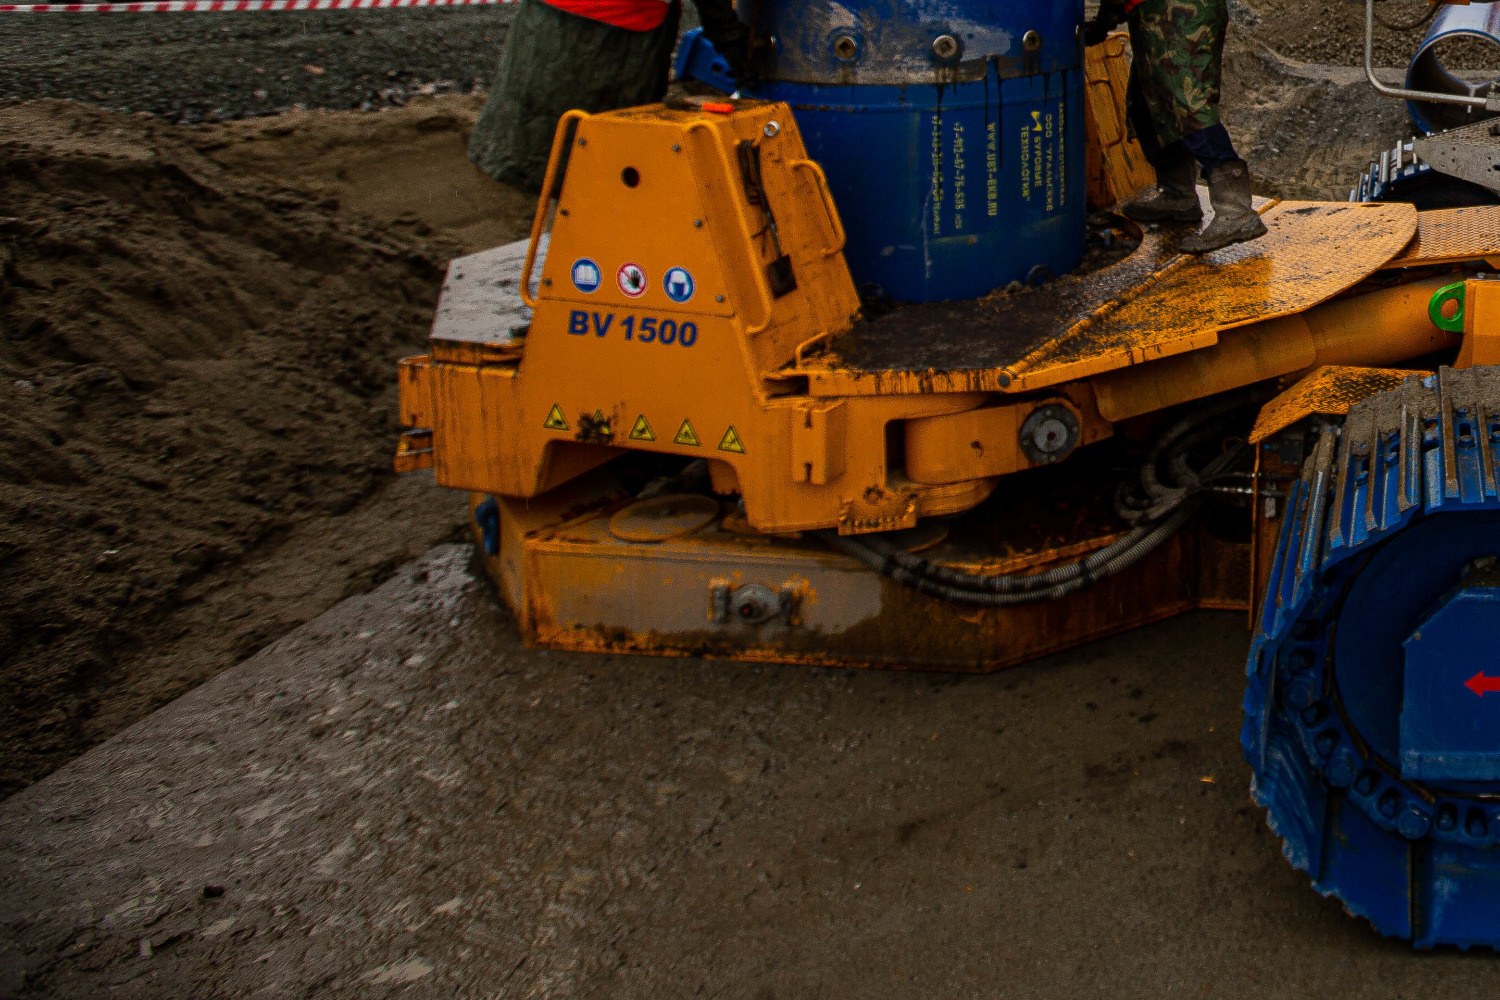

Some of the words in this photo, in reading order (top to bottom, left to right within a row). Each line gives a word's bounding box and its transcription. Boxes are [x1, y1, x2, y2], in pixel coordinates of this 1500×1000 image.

[1045, 114, 1053, 137] ООО
[568, 310, 614, 338] BV
[620, 315, 698, 347] 1500
